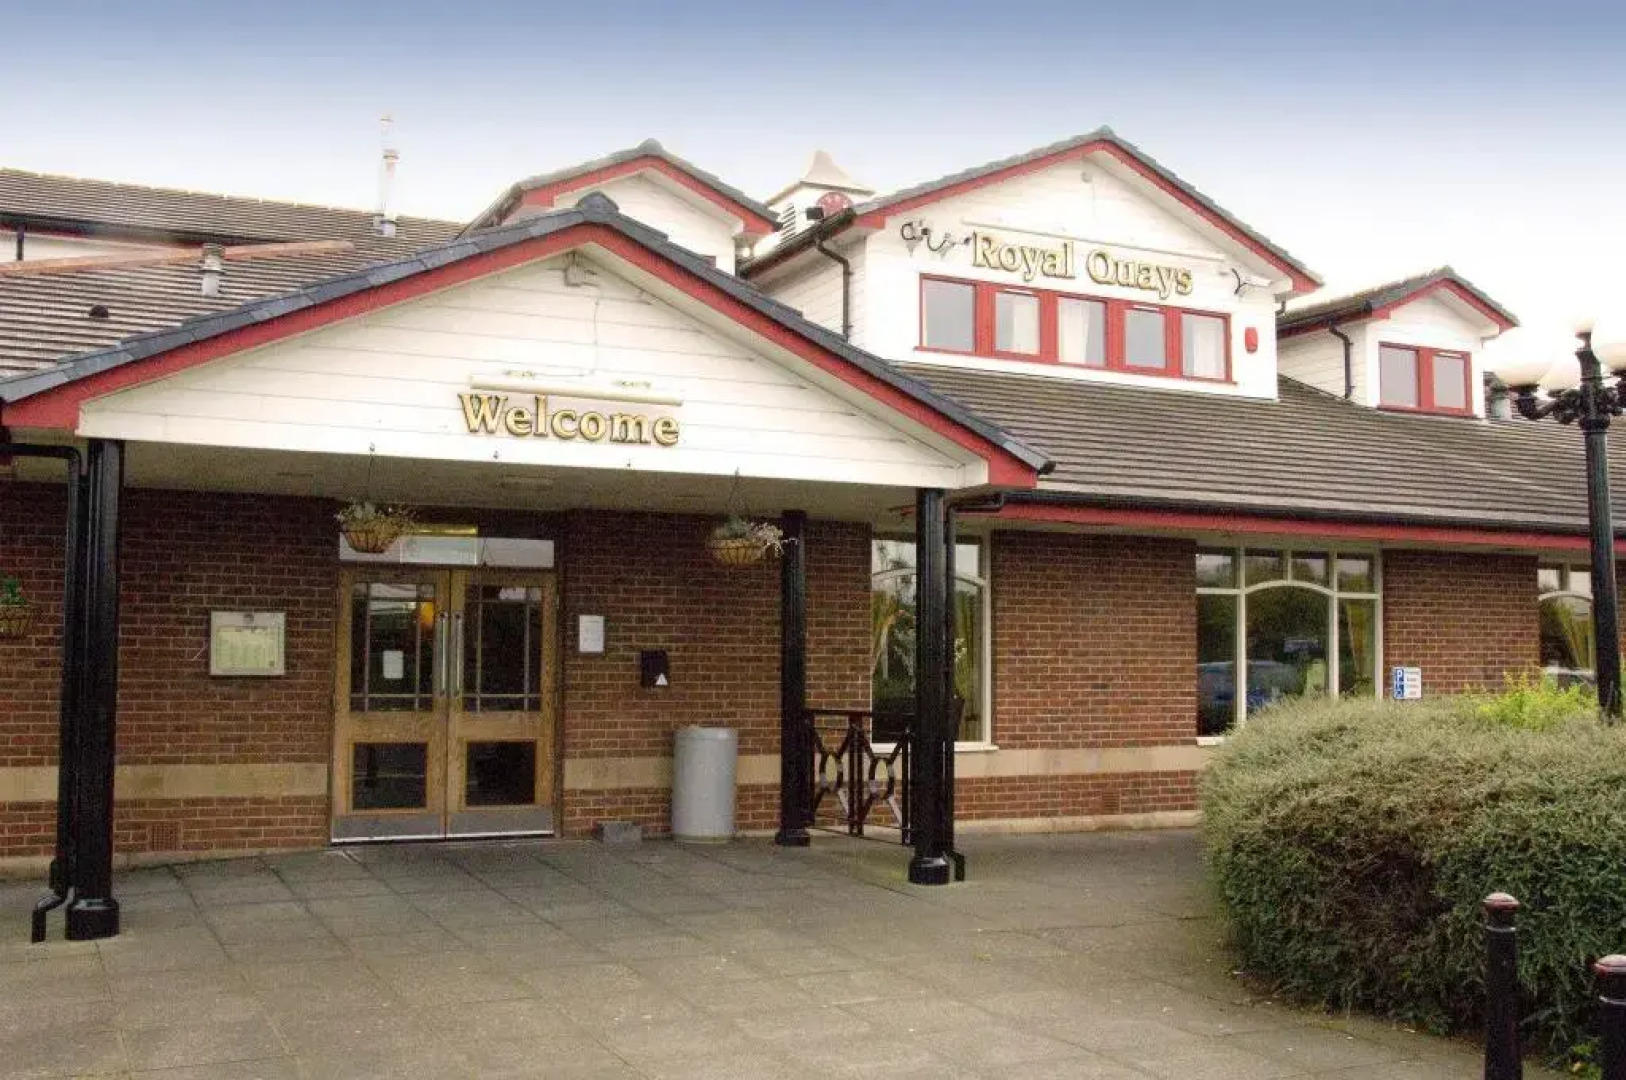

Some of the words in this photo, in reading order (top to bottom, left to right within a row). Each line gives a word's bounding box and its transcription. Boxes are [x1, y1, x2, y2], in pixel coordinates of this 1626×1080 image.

[972, 230, 1077, 282] Royal
[1086, 248, 1194, 300] Quays
[458, 393, 679, 446] Welcome
